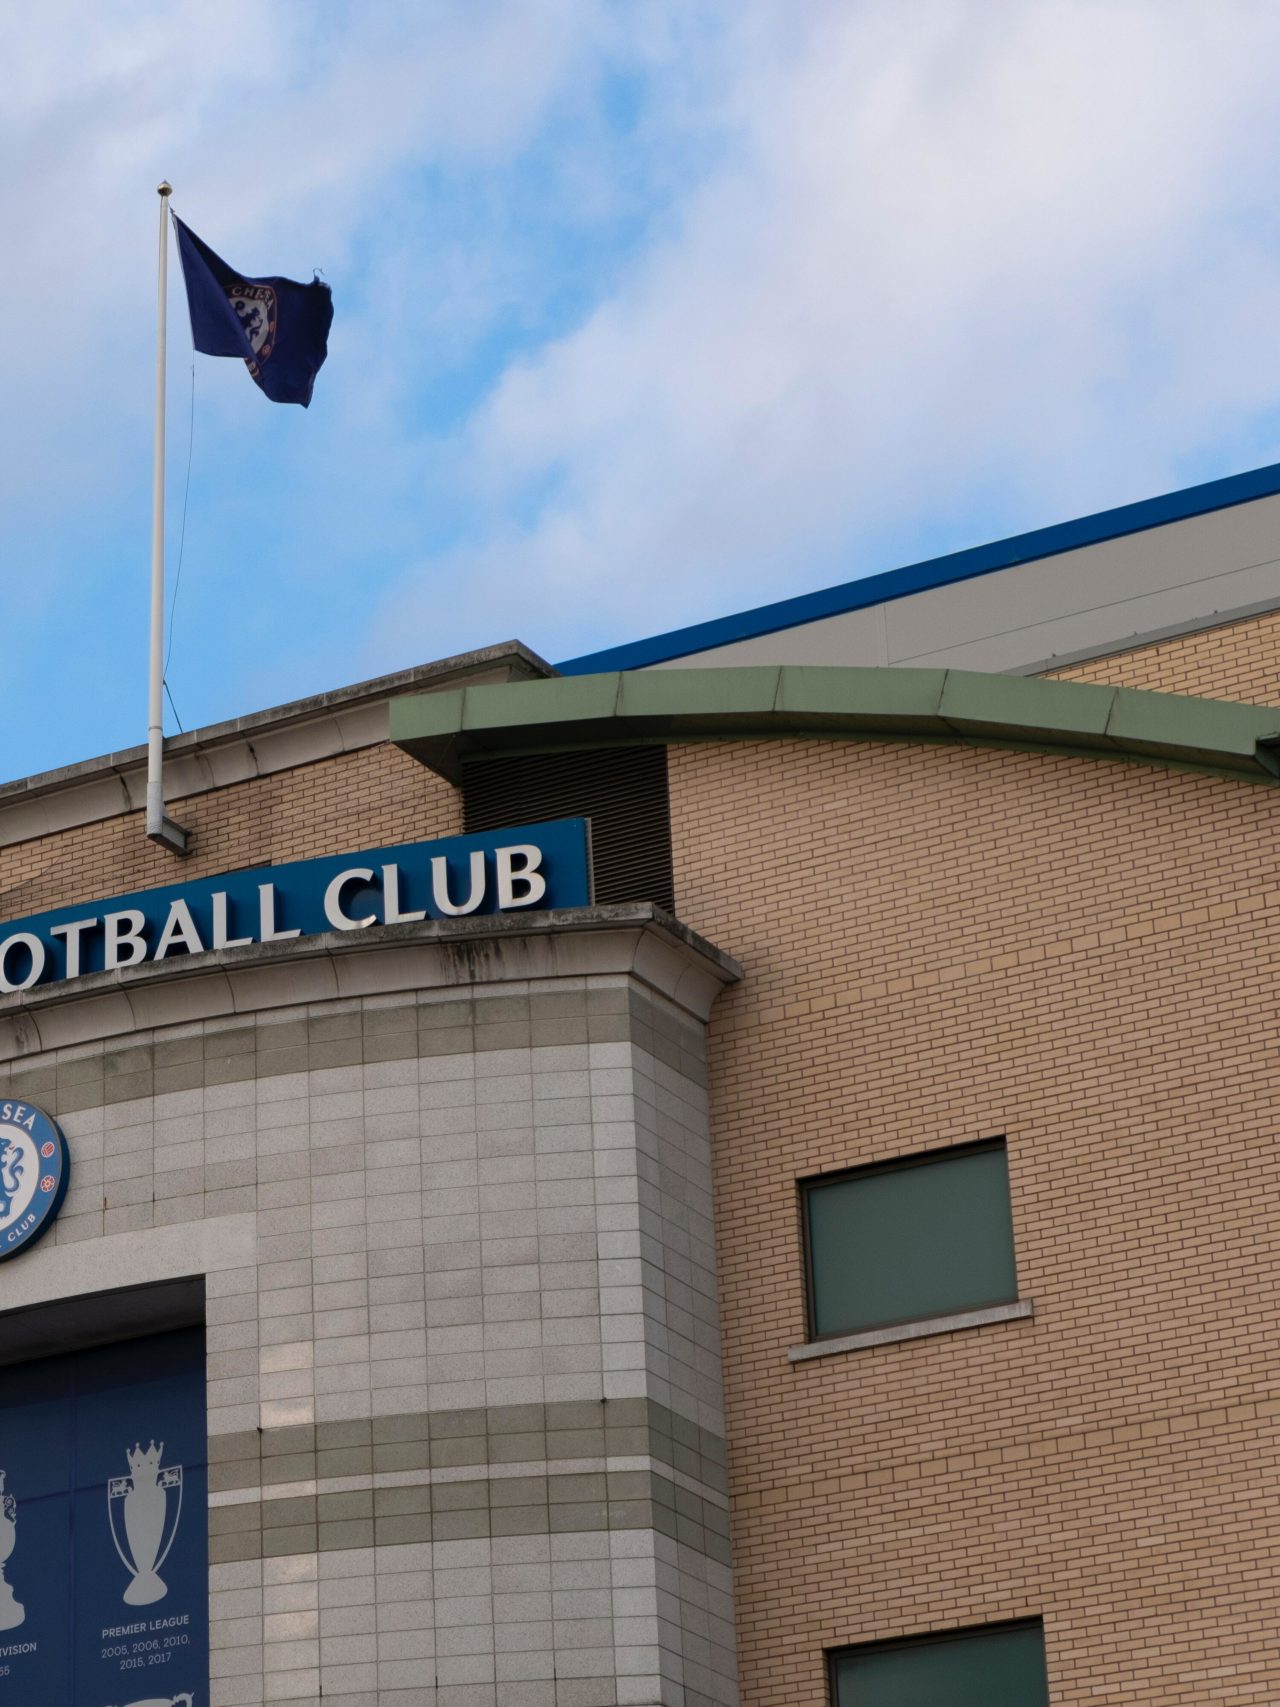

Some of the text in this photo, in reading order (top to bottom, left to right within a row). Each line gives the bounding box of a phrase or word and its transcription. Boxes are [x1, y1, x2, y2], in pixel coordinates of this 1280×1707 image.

[323, 844, 547, 931] CLUB
[7, 1212, 36, 1243] CLUB
[101, 1614, 190, 1639] PREMIER LEAGUE
[101, 1634, 191, 1659] 2005, 2006, 2010,
[120, 1651, 172, 1670] 2015, 2017
